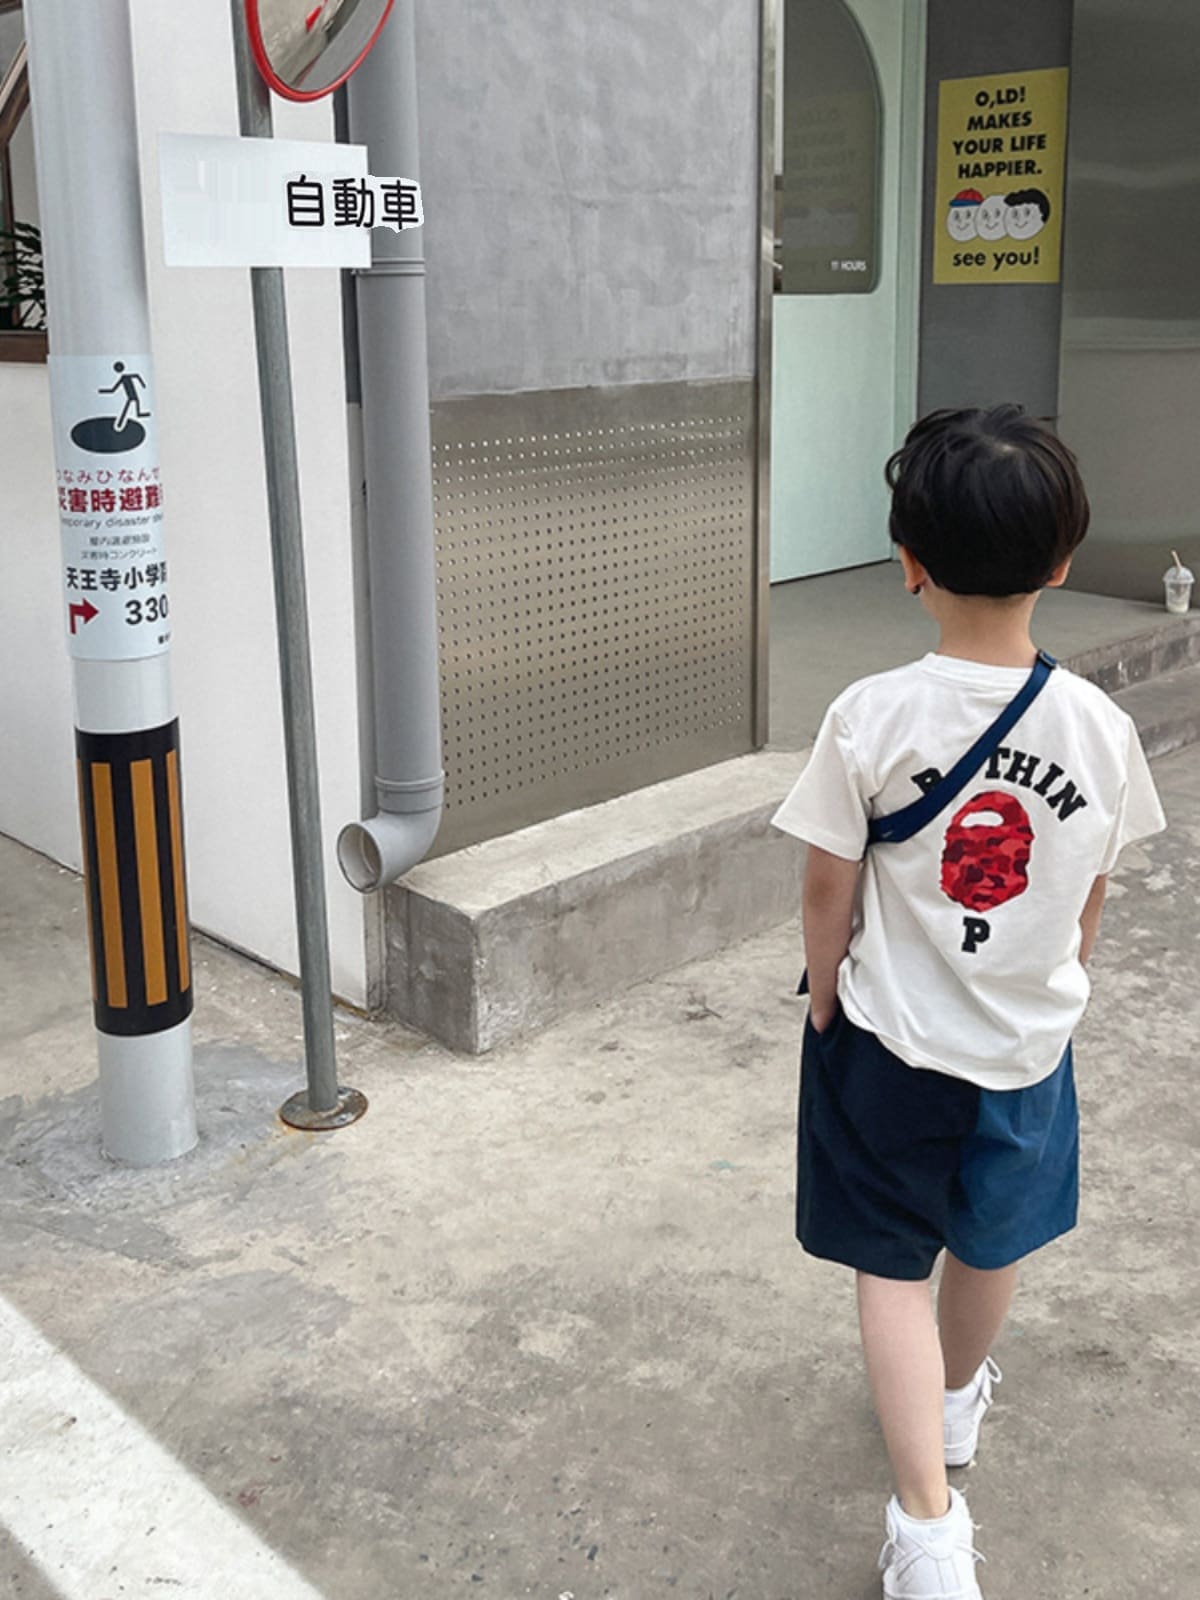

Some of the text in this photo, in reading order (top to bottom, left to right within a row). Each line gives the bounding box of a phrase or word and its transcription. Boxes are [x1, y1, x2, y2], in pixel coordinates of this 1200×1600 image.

[975, 86, 1025, 108] O,LD!
[967, 111, 1032, 131] MAKES
[953, 134, 1047, 155] YOUR LIFE
[957, 160, 1042, 179] HAPPIER.
[287, 174, 419, 230] 自動車
[953, 246, 1039, 271] see you!
[105, 514, 150, 528] disaster
[961, 916, 990, 953] P
